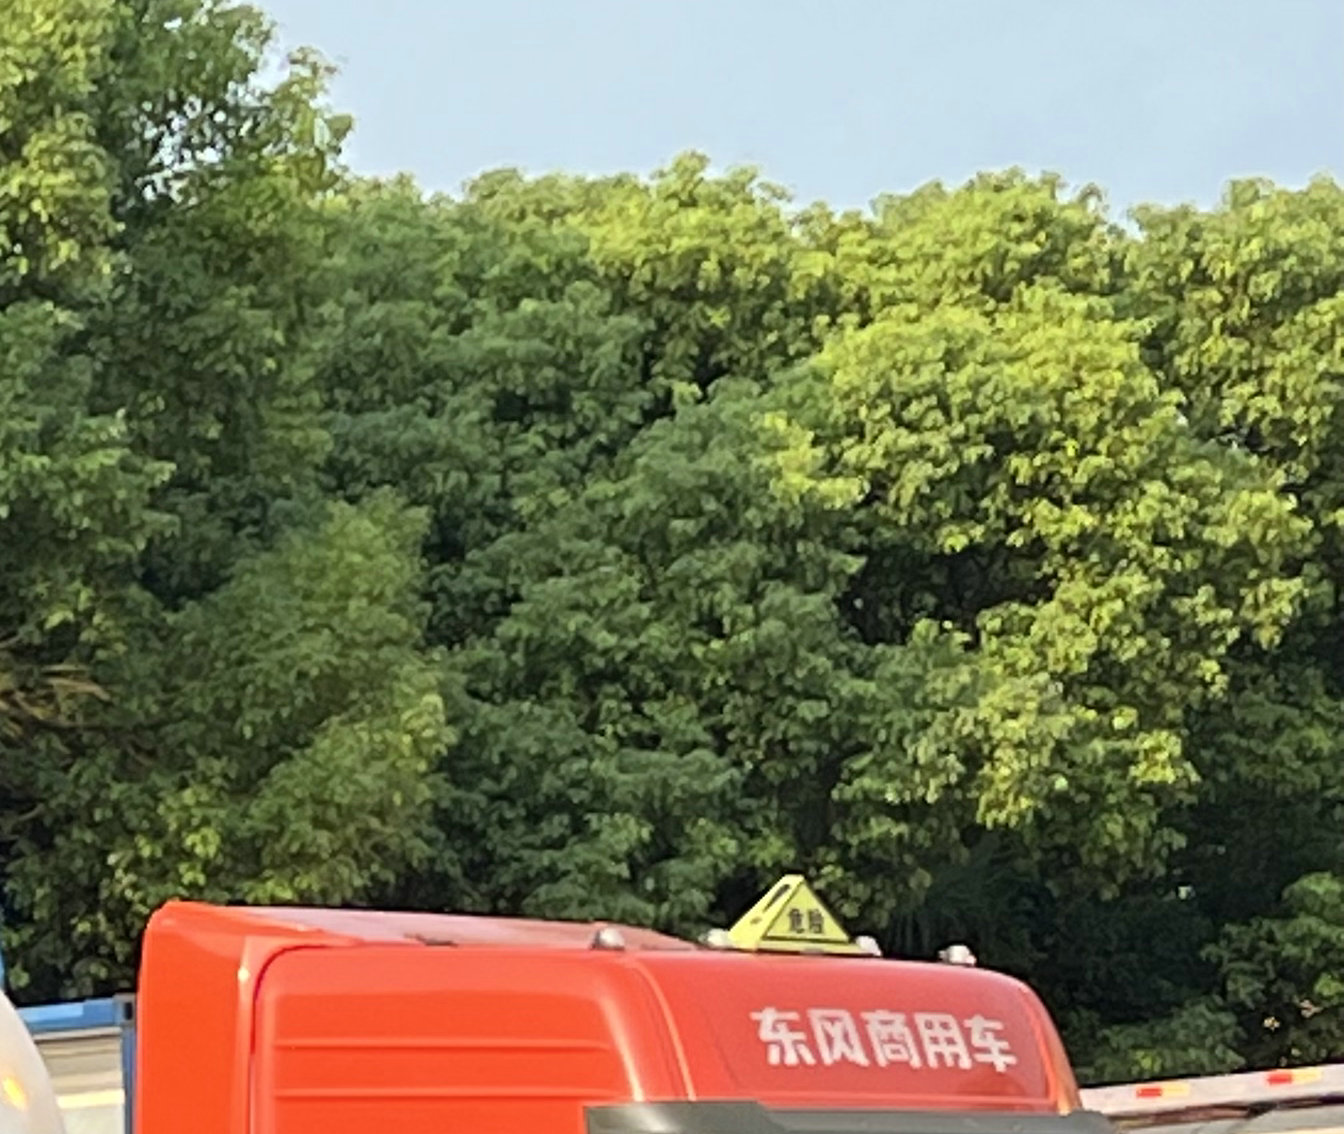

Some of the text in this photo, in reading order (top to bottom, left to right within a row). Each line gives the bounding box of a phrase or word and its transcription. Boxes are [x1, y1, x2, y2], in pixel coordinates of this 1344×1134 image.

[750, 1006, 1018, 1073] 东风商用车
